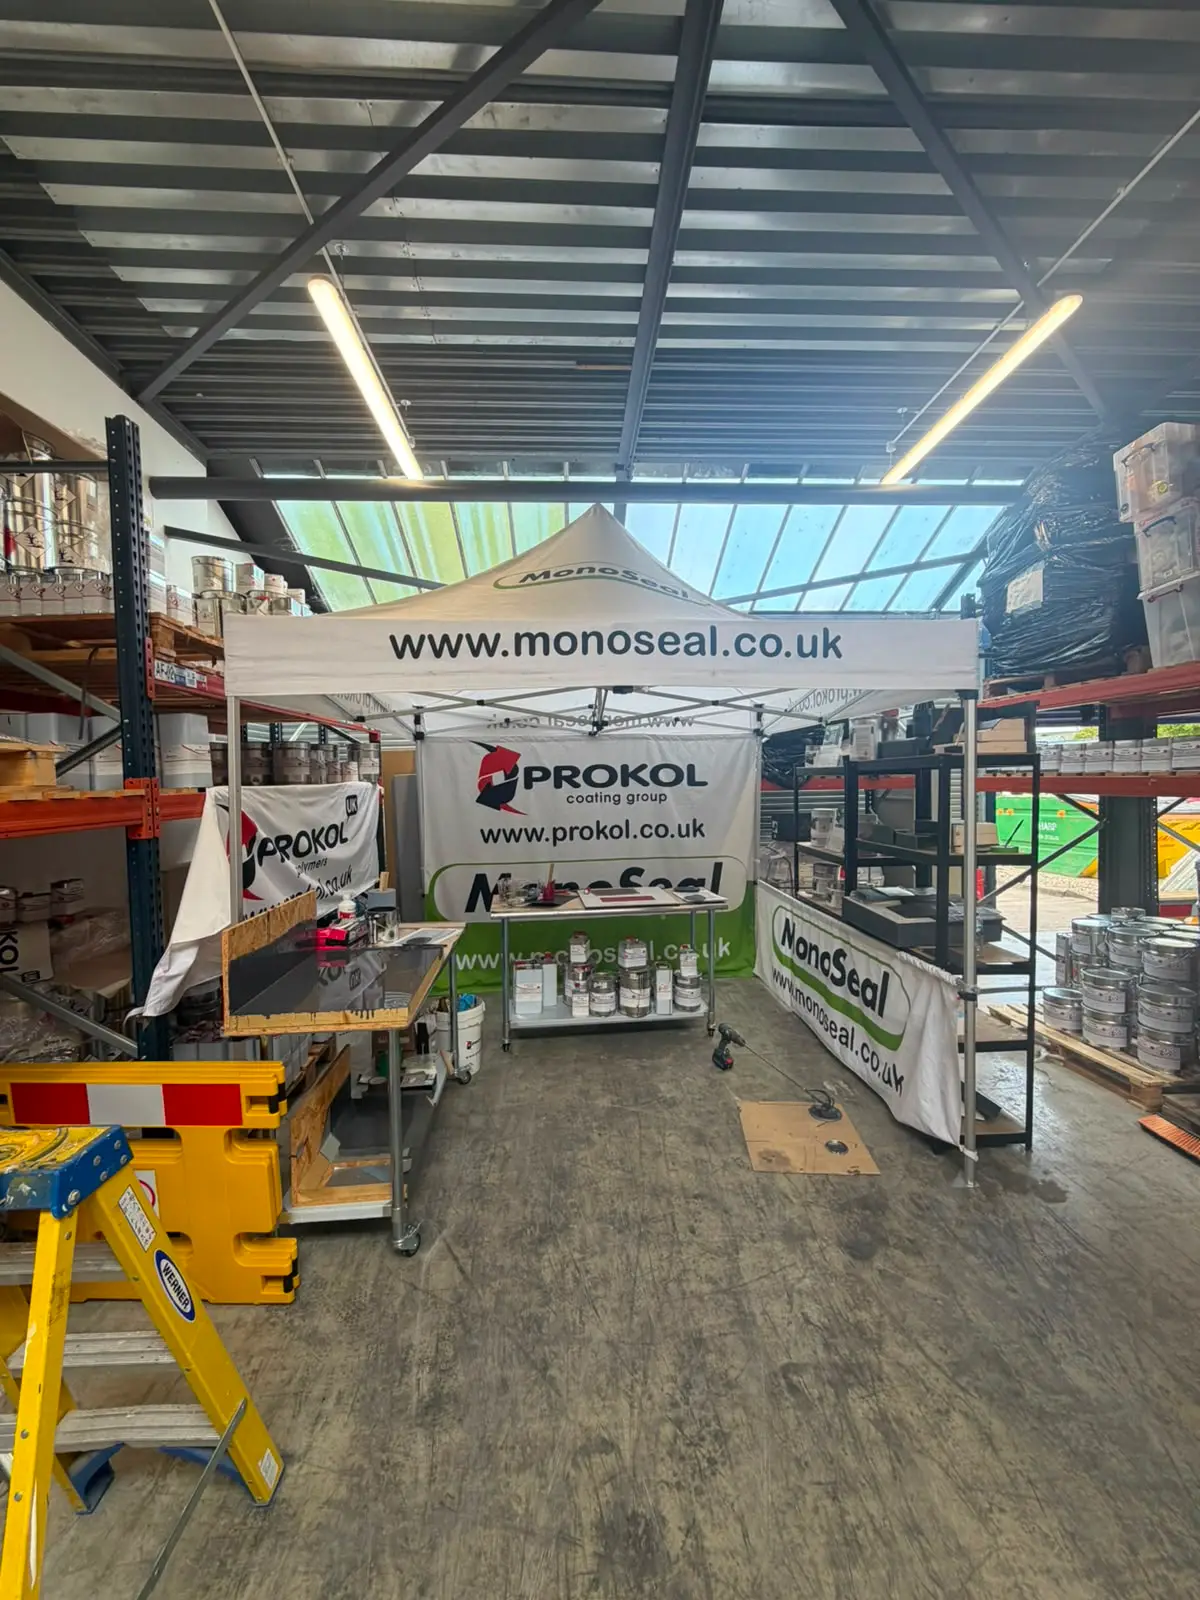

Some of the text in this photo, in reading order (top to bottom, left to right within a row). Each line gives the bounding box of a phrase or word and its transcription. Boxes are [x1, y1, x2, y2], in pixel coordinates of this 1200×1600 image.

[519, 565, 689, 599] MonoSeal
[389, 624, 843, 661] www.monoseal.co.uk
[523, 763, 709, 790] PROKOL
[566, 790, 668, 806] coating group
[257, 822, 348, 867] PROKOL
[480, 817, 706, 847] www.prokol.co.uk
[772, 963, 905, 1098] www.monoseal.co.uk
[161, 1262, 191, 1310] WERNER
